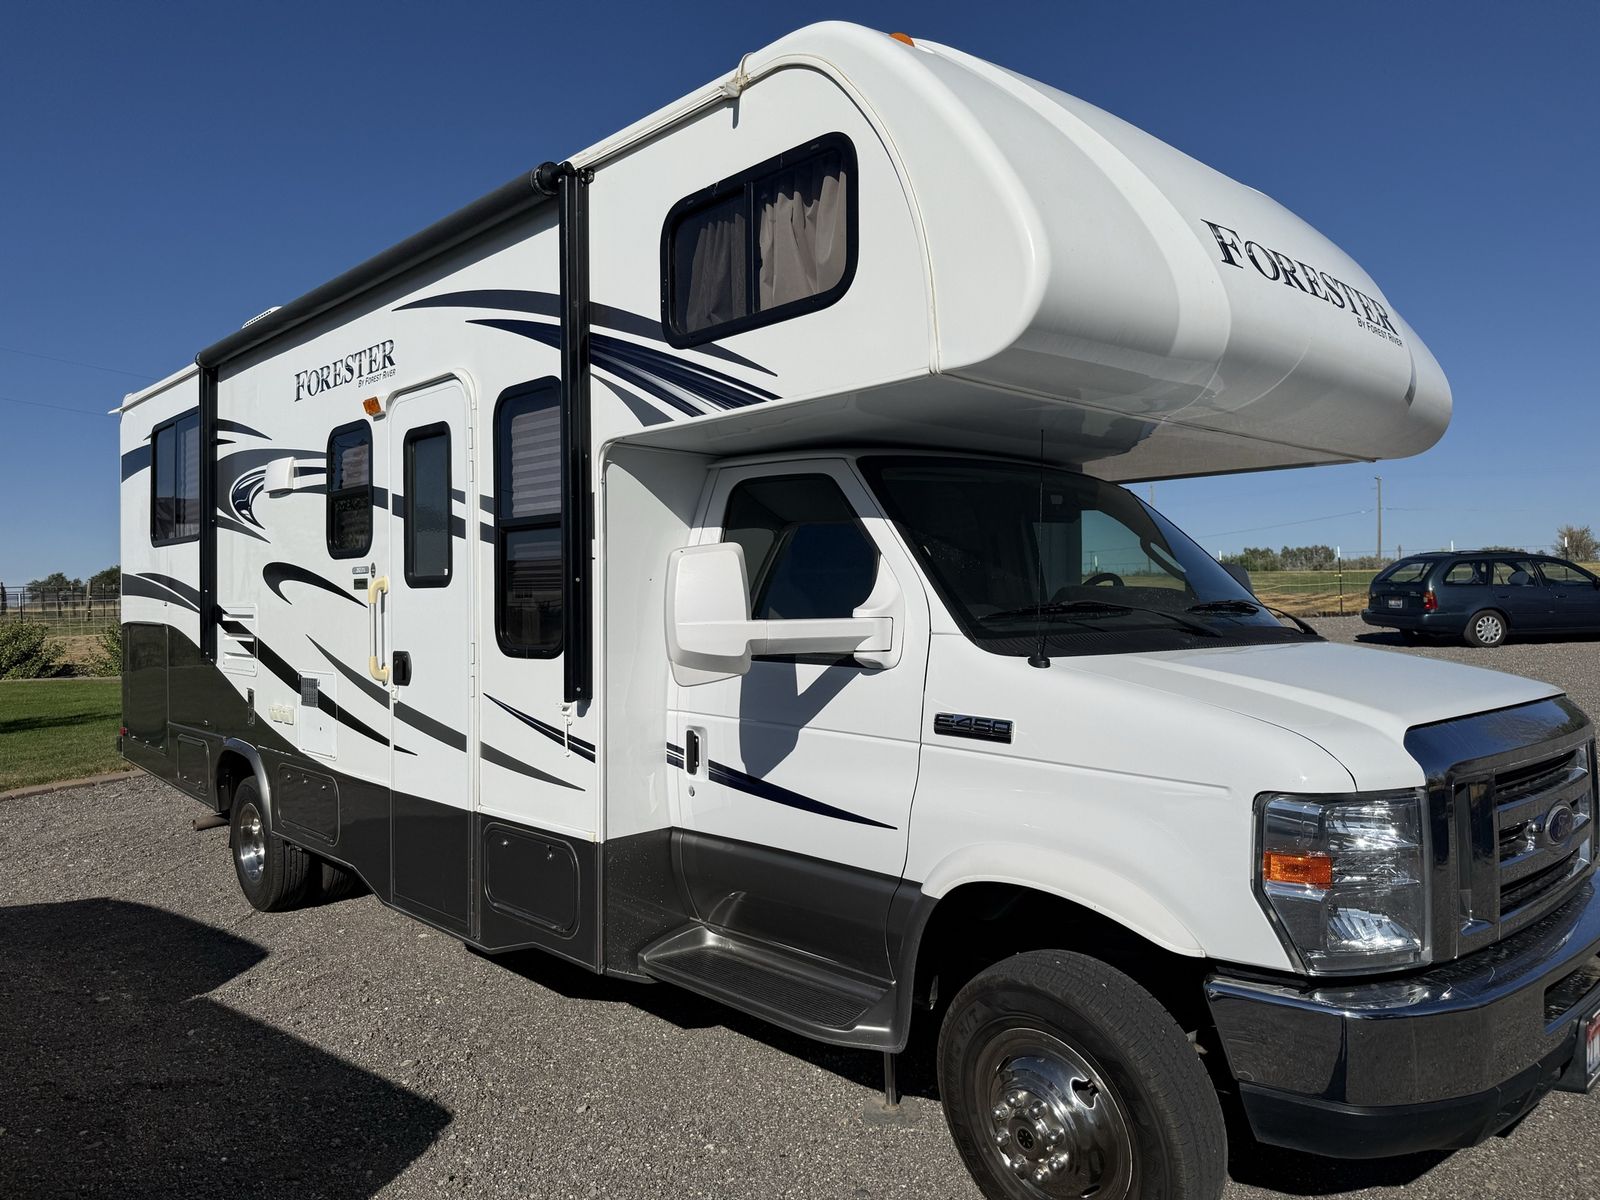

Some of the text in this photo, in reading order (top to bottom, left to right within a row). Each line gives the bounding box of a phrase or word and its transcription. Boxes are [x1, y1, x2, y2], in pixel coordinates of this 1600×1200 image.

[1200, 218, 1399, 336] FORESTER
[1366, 321, 1388, 340] FOREST
[1387, 332, 1404, 348] RIVER
[294, 339, 396, 402] FORESTER
[365, 373, 382, 385] FOREST
[382, 368, 396, 379] RIVER
